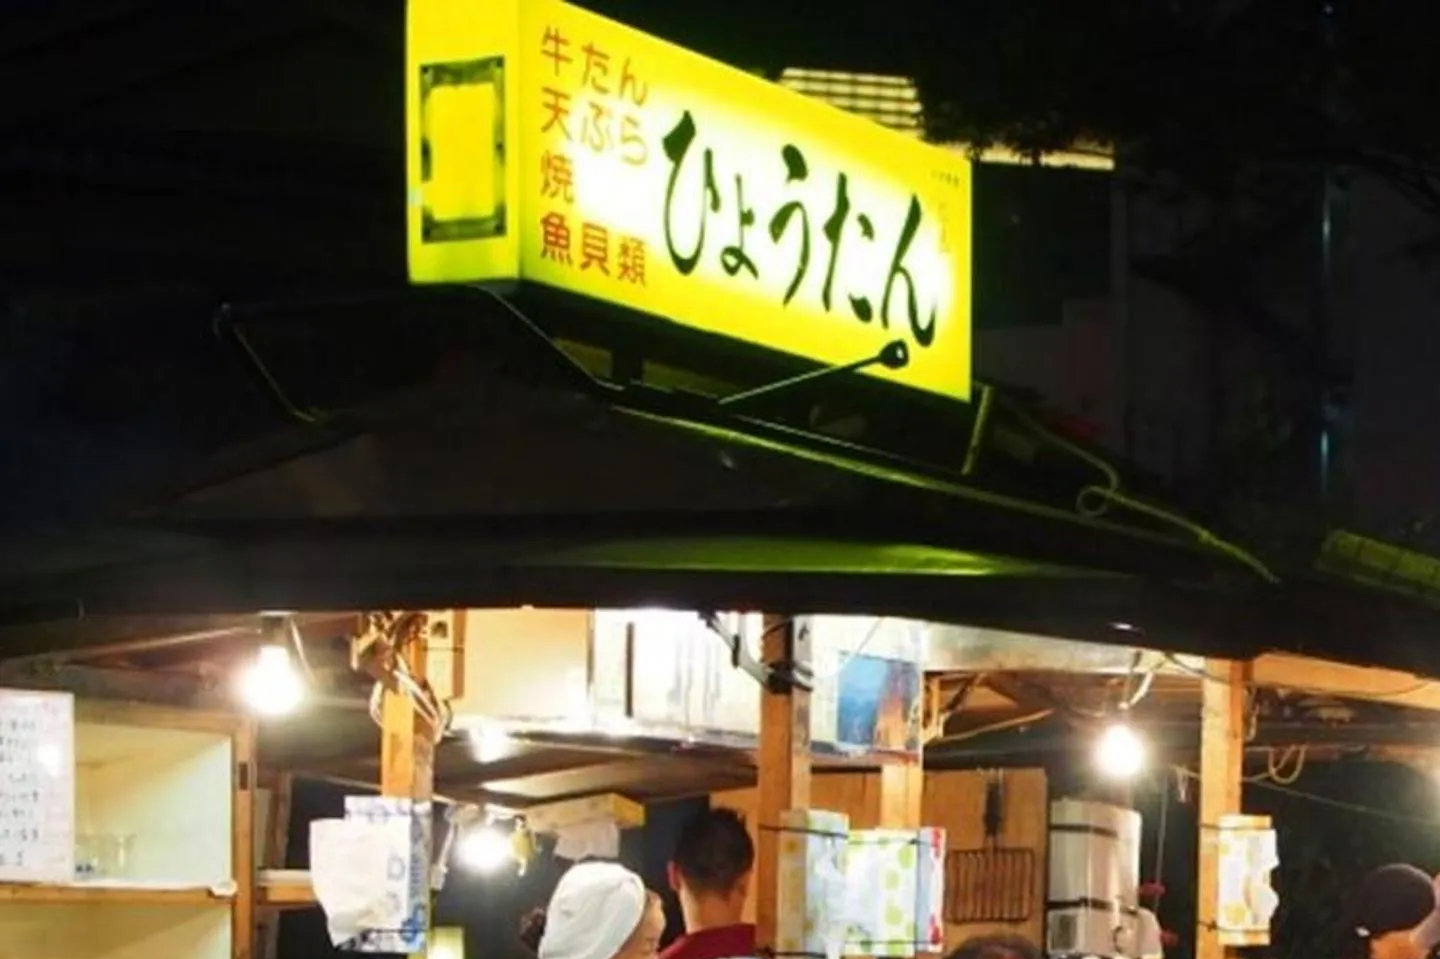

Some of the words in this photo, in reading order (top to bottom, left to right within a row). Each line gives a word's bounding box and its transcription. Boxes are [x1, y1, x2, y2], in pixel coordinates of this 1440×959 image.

[541, 26, 648, 107] 牛たん
[540, 211, 647, 288] 魚貝類
[663, 110, 936, 348] ひょうたん
